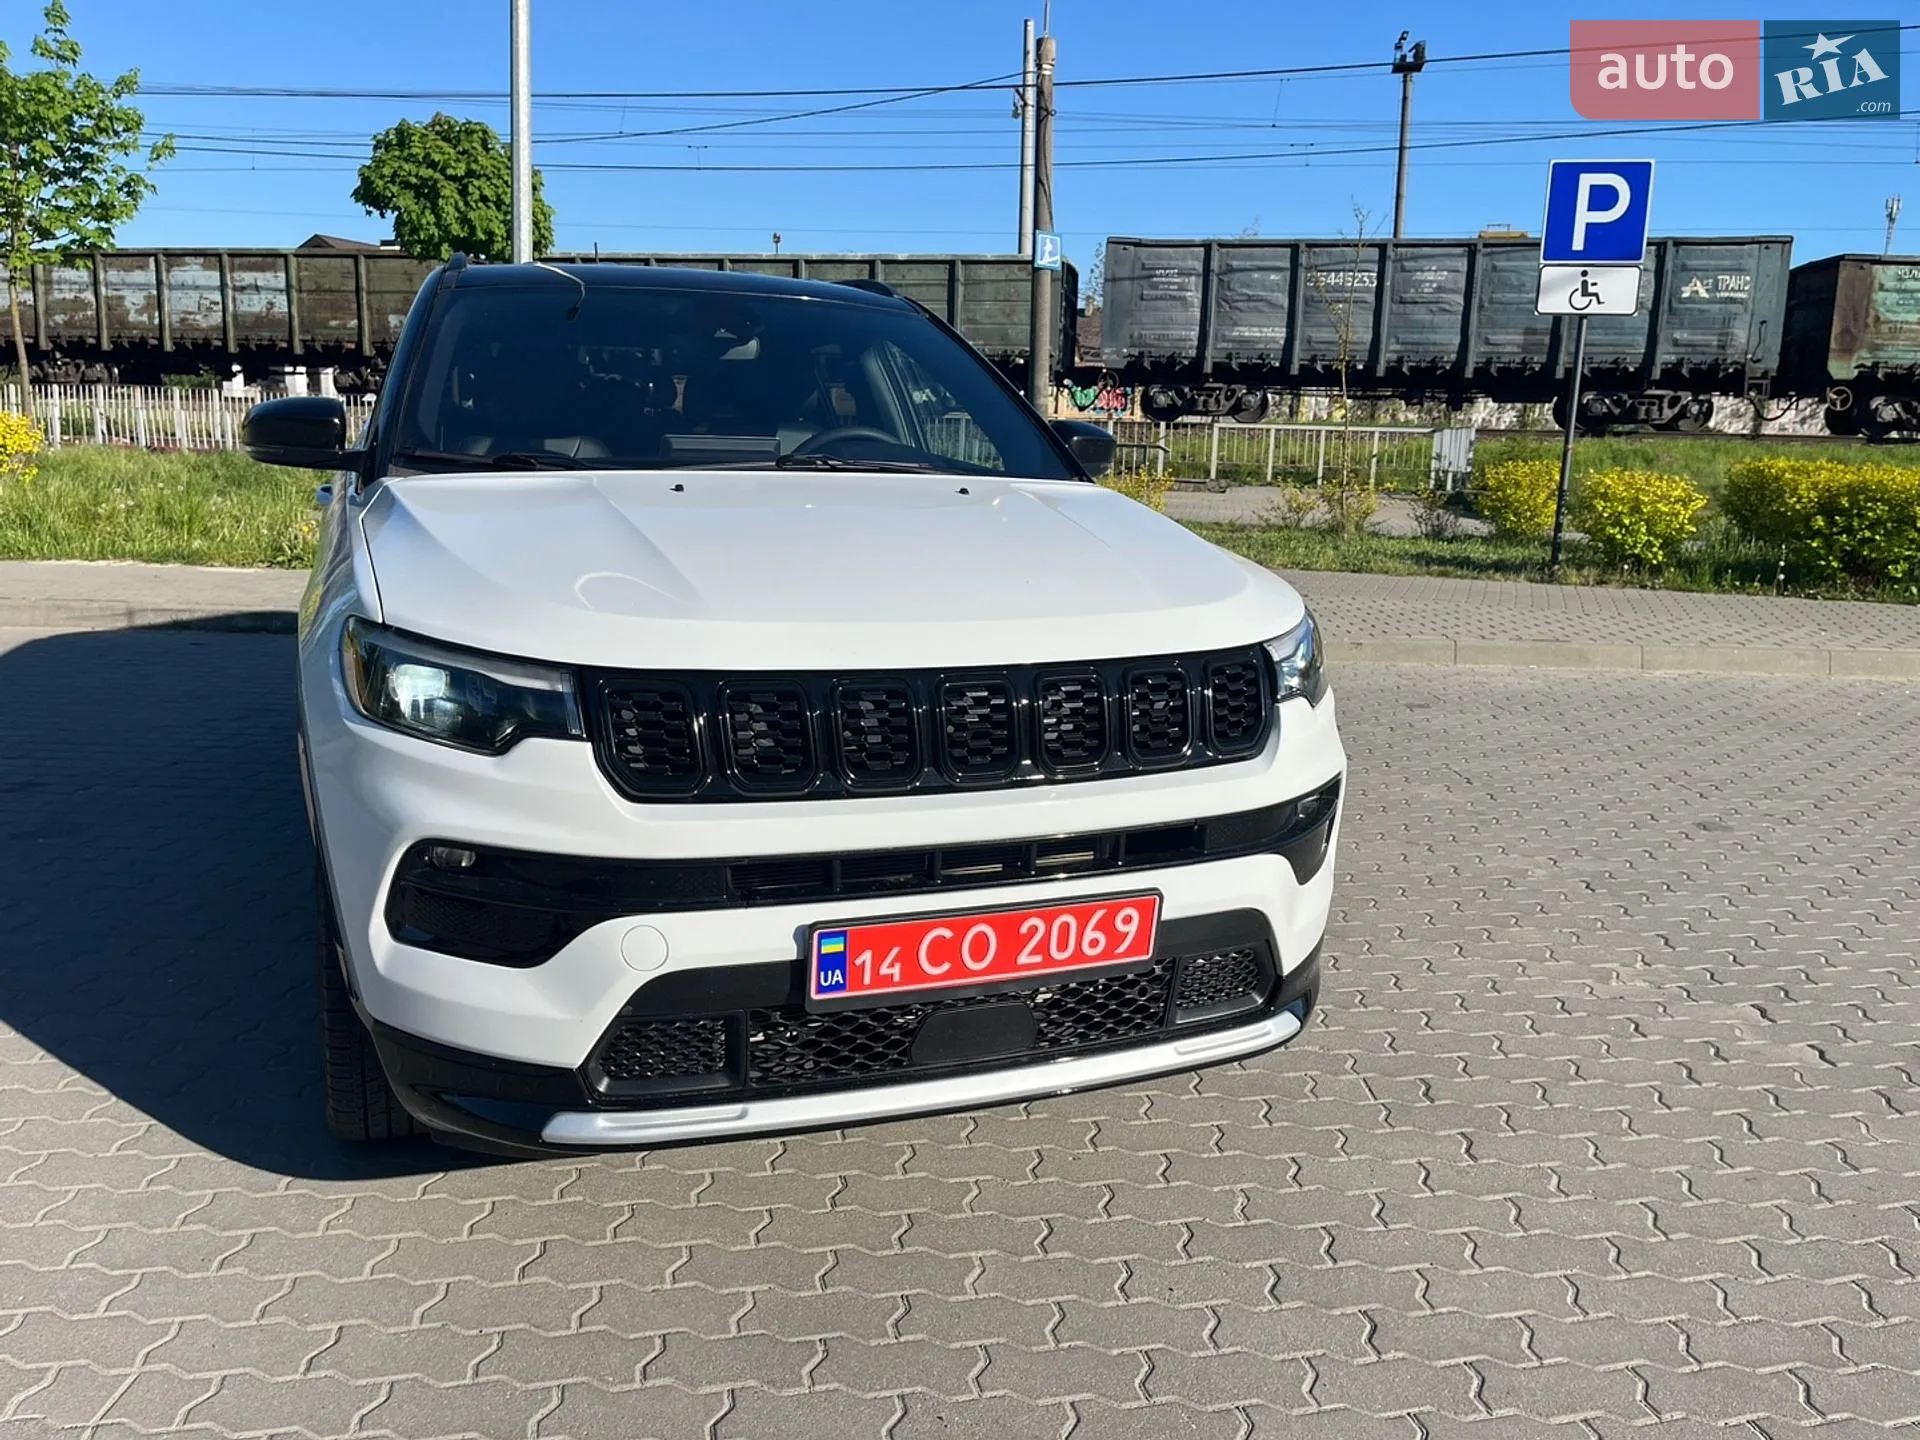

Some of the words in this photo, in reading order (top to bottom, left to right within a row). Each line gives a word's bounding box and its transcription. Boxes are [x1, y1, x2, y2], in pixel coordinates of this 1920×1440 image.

[1571, 172, 1631, 251] P
[820, 970, 844, 987] UA
[852, 946, 902, 986] 14
[917, 923, 997, 975] CO
[1016, 906, 1140, 966] 2069
